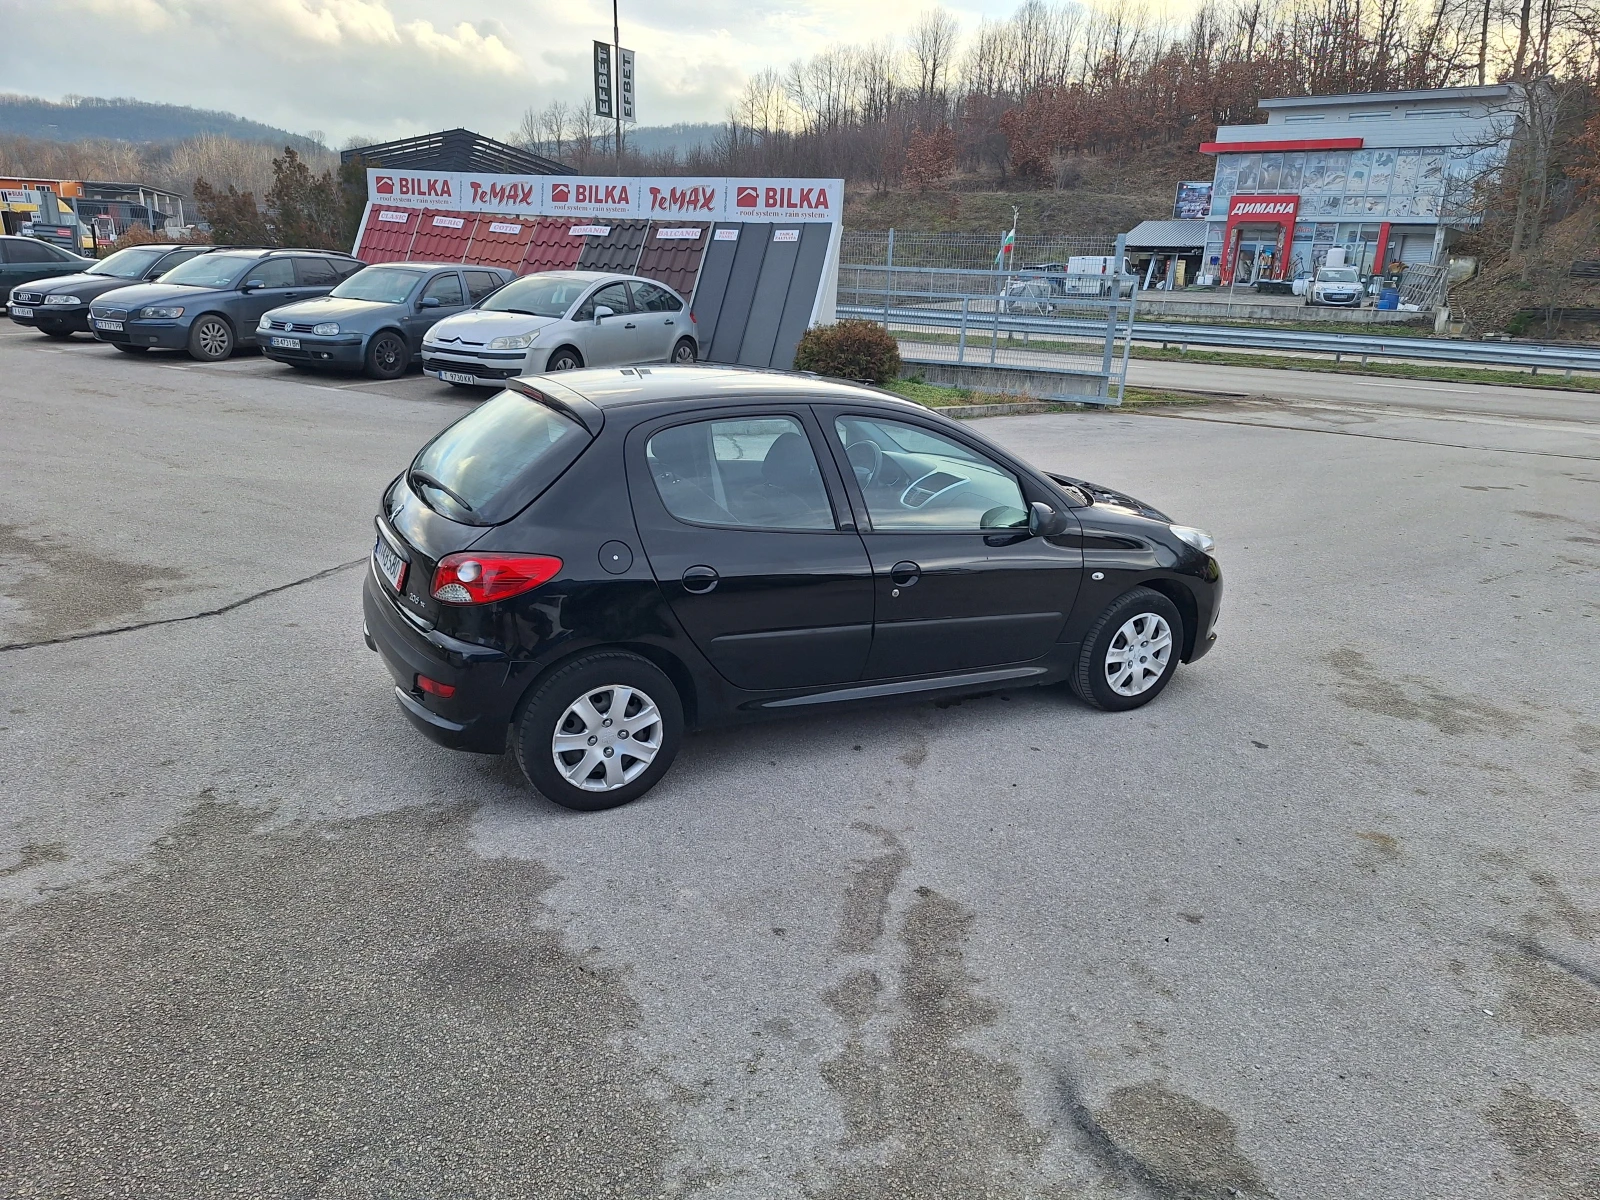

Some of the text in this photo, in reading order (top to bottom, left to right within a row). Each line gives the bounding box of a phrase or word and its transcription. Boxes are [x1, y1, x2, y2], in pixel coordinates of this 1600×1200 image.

[597, 46, 608, 113] EFBET
[623, 53, 632, 117] EFBET
[399, 177, 452, 197] BILKA
[470, 181, 533, 206] TeMAX
[575, 184, 629, 204] BILKA
[649, 186, 716, 213] TeMAX
[764, 187, 829, 209] BILKA
[380, 211, 407, 221] CLASIC
[755, 210, 779, 218] system
[1230, 202, 1295, 216] ДИМАНА
[435, 218, 462, 227] IBERIC
[493, 224, 518, 232] GOTIC
[571, 226, 608, 234] ROMANIC
[658, 229, 700, 237] BALCANIC
